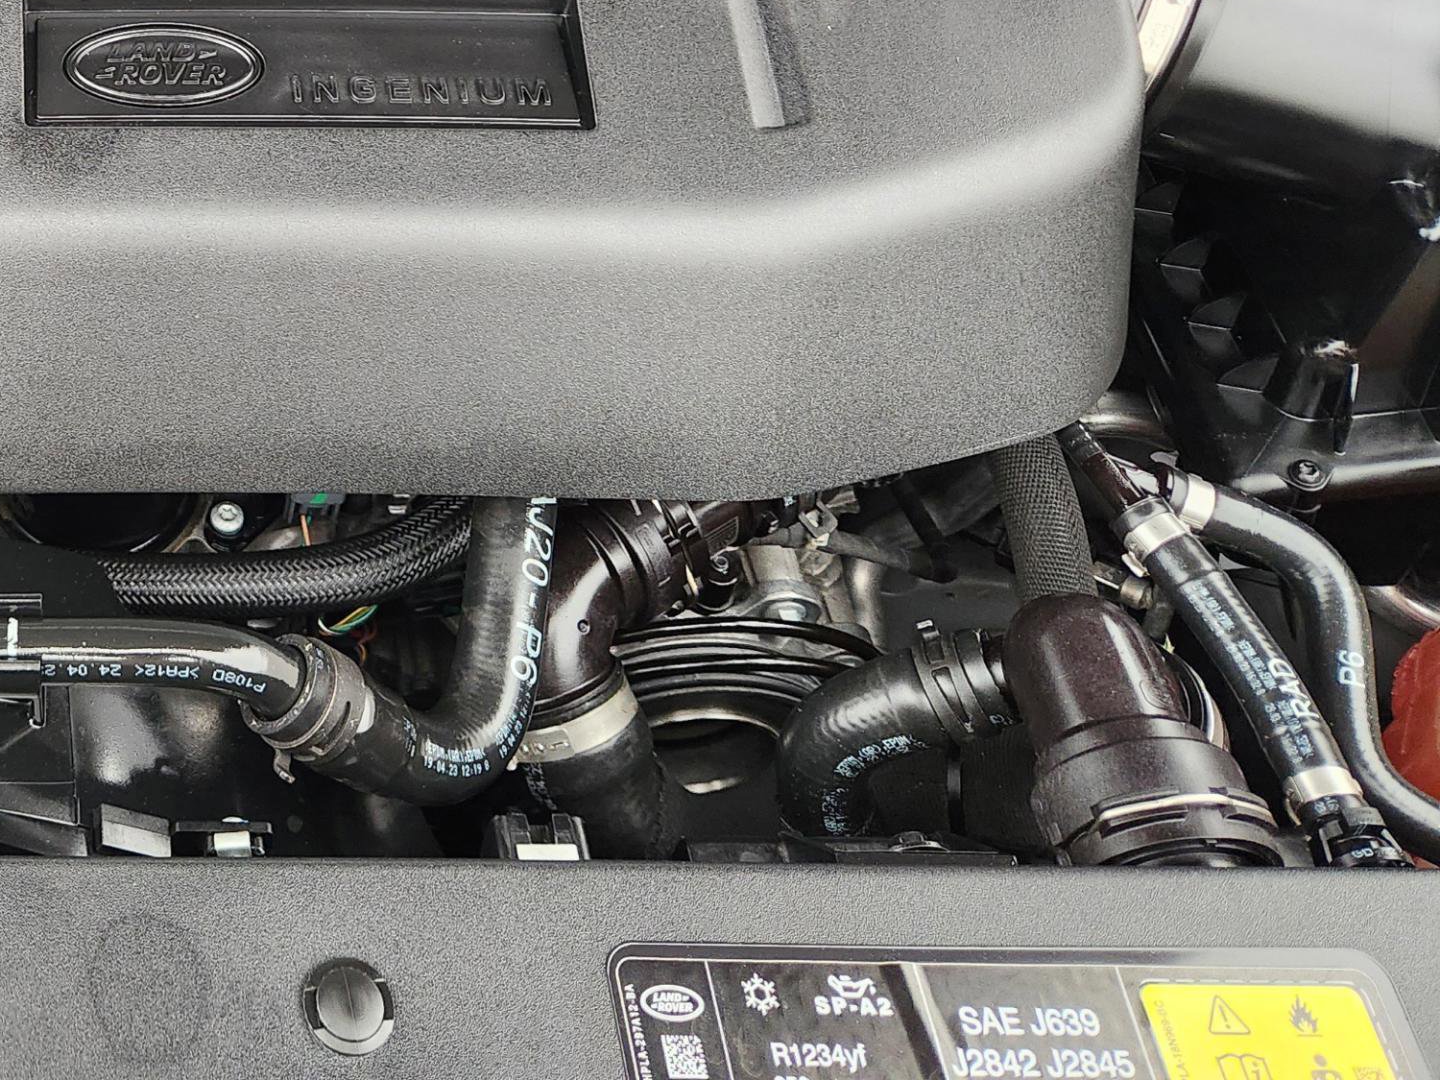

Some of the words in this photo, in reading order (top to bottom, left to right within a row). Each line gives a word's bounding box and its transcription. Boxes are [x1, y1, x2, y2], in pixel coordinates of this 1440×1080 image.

[107, 42, 196, 62] LAND
[114, 62, 227, 86] ROVER
[290, 73, 552, 107] INGENIUM
[1337, 649, 1365, 689] P6
[1266, 657, 1320, 721] RAD
[653, 991, 682, 1003] LAND
[657, 1001, 695, 1013] ROVER
[813, 995, 895, 1017] SP-A2
[958, 1006, 1025, 1036] SAE
[1029, 1007, 1101, 1037] J639
[769, 1041, 868, 1074] R1234yf
[951, 1046, 1042, 1078] J2842
[1045, 1046, 1136, 1079] J2845
